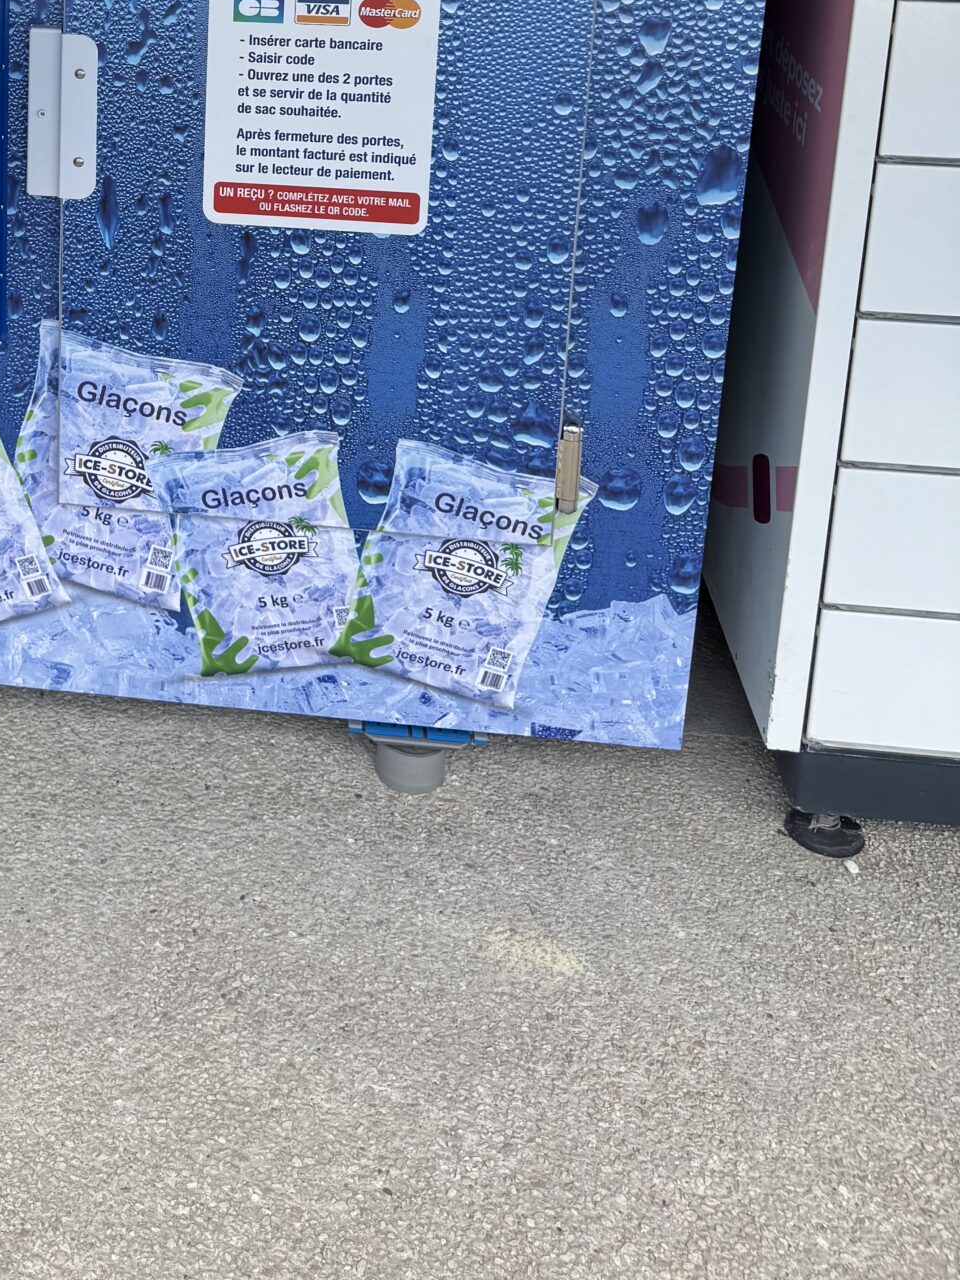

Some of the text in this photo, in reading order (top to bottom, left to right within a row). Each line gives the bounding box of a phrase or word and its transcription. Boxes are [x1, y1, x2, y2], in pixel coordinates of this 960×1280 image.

[306, 4, 340, 16] VISA
[360, 6, 419, 19] MasterCard
[250, 35, 383, 51] Insérer carte bancaire
[248, 52, 315, 65] Saisir code
[248, 69, 393, 87] Ouvrez une des 2 portes
[238, 87, 391, 103] et se servir de la quantité
[238, 103, 341, 118] de sac souhaitée.
[237, 128, 404, 149] Après fermeture des portes,
[237, 145, 416, 165] le montant facturé est indiqué
[236, 163, 394, 181] sur le lecteur de paiement.
[220, 187, 234, 197] UN
[237, 187, 265, 201] REÇU
[277, 191, 329, 203] COMPLÉTEZ
[332, 194, 355, 204] AVEC
[358, 196, 386, 206] VOTRE
[389, 198, 411, 207] MAIL
[260, 202, 369, 217] OU FLASHEZ LE QR CODE.
[77, 381, 187, 427] Glaçons
[202, 482, 307, 509] Glaçons
[81, 506, 112, 526] 5 kg
[435, 493, 543, 540] Glaçons
[233, 540, 306, 558] ICE-STORE
[428, 554, 503, 584] ICE-STORE
[258, 595, 289, 608] 5 kg
[423, 607, 455, 628] 5 kg
